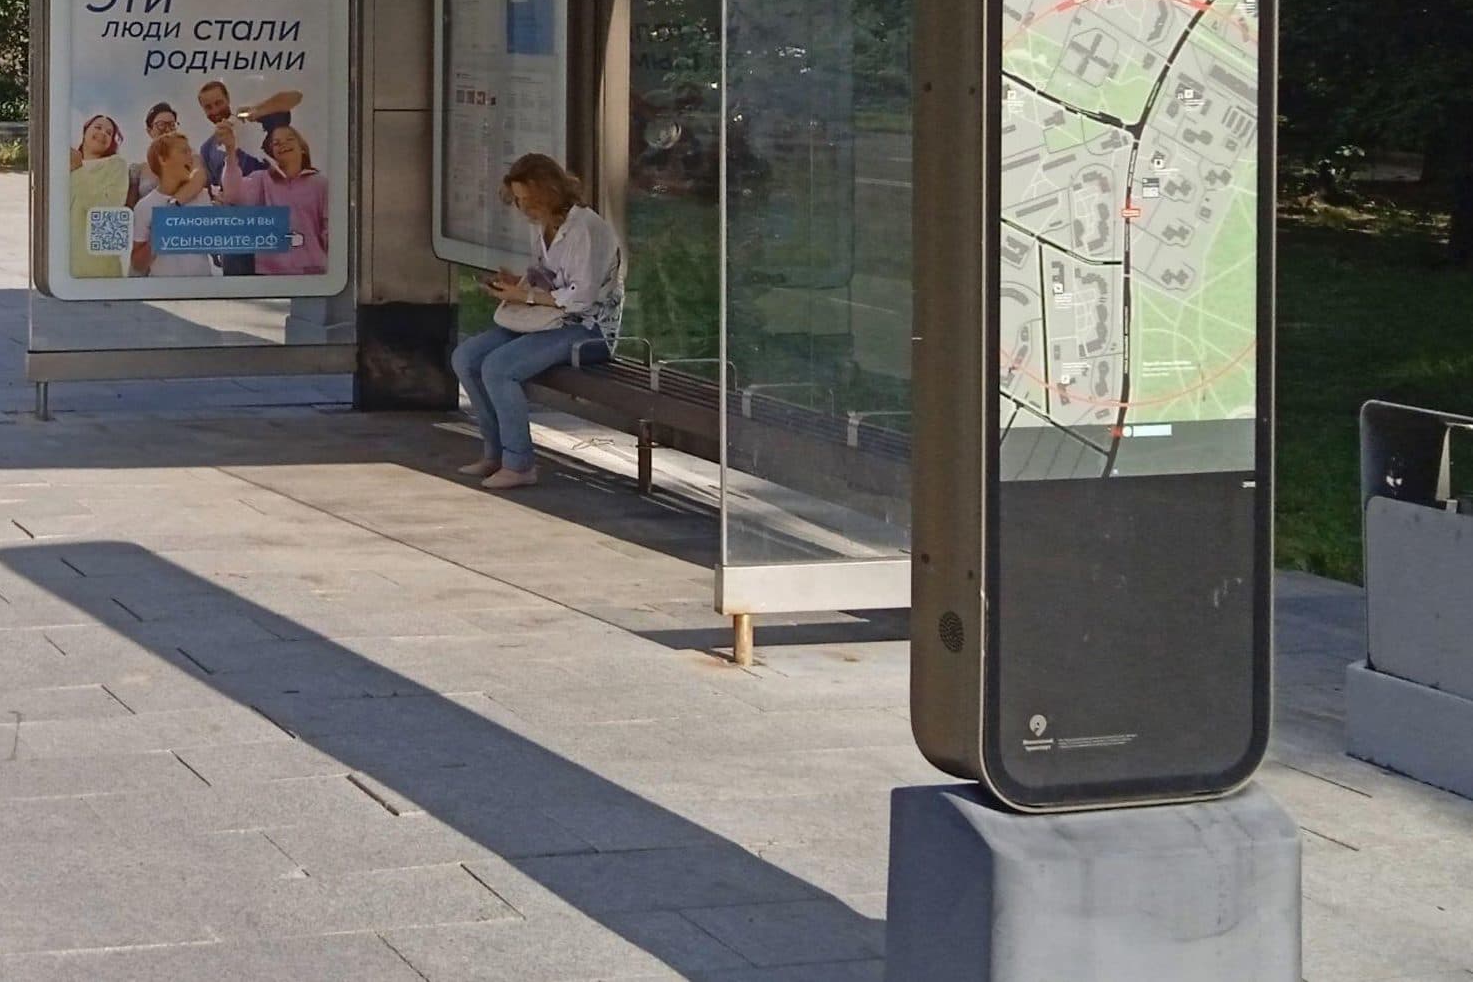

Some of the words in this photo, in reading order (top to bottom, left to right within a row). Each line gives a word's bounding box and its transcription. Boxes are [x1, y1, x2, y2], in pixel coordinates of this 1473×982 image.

[101, 21, 182, 41] люди
[193, 19, 301, 42] стали
[144, 49, 306, 76] родными
[161, 232, 278, 249] усыновите.рф
